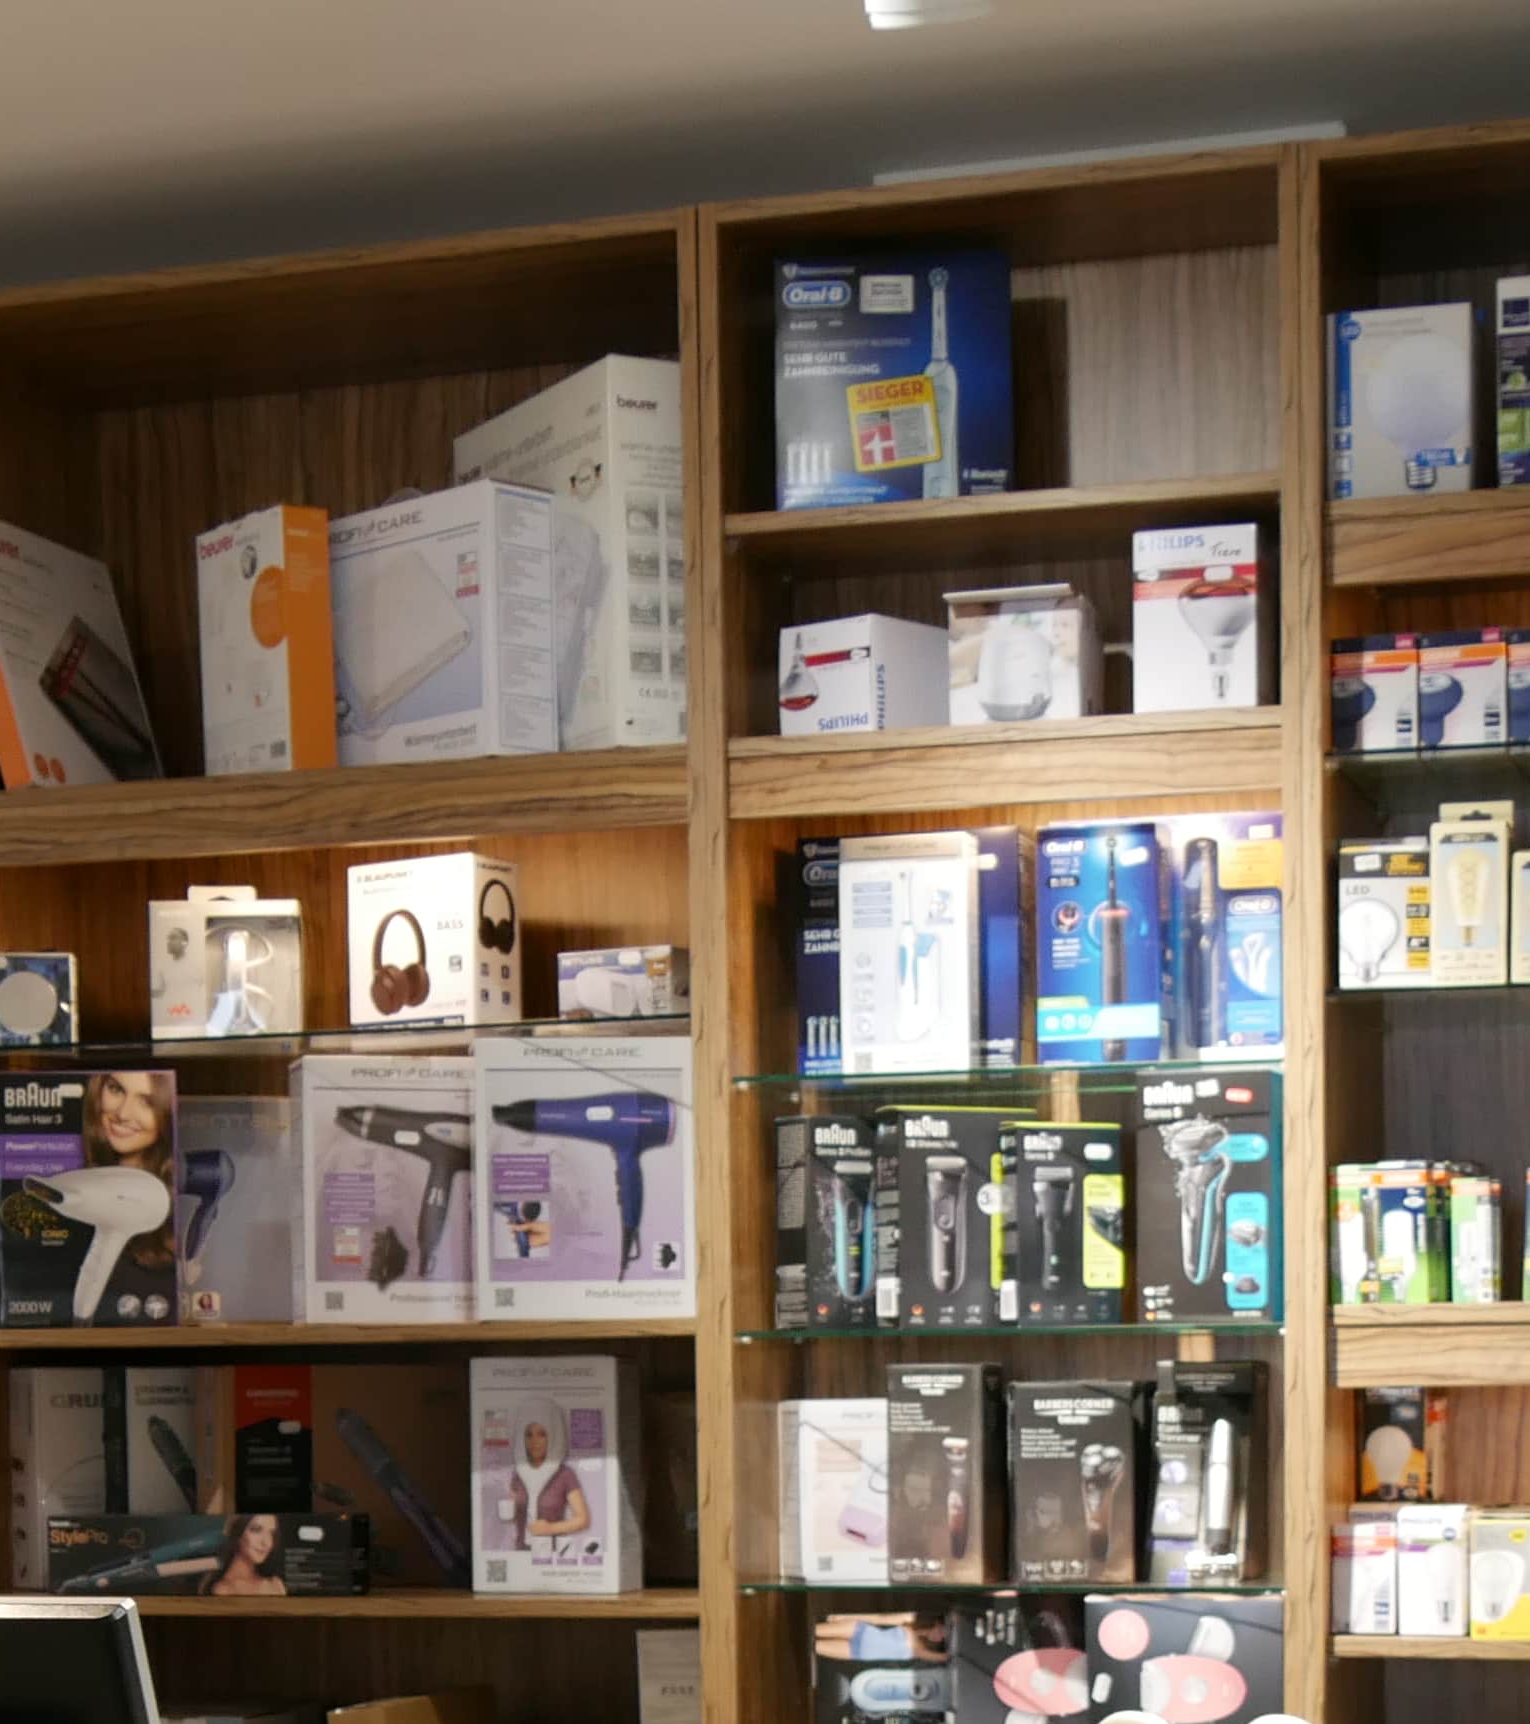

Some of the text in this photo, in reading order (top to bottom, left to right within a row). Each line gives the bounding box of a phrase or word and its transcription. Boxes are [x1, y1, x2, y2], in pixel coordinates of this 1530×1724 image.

[857, 382, 924, 402] SIEGER
[616, 396, 657, 410] beurer
[523, 1048, 641, 1058] PROFI CARE
[351, 1067, 468, 1078] PROFI CARE
[4, 1082, 61, 1107] BRAUN
[1144, 1082, 1193, 1105] BRAUN
[6, 1114, 62, 1124] Satin Hair 3
[905, 1116, 949, 1138] BRAUN
[815, 1123, 856, 1145] BRAUN
[1024, 1132, 1062, 1151] BRAUN
[50, 1529, 108, 1548] StylePro
